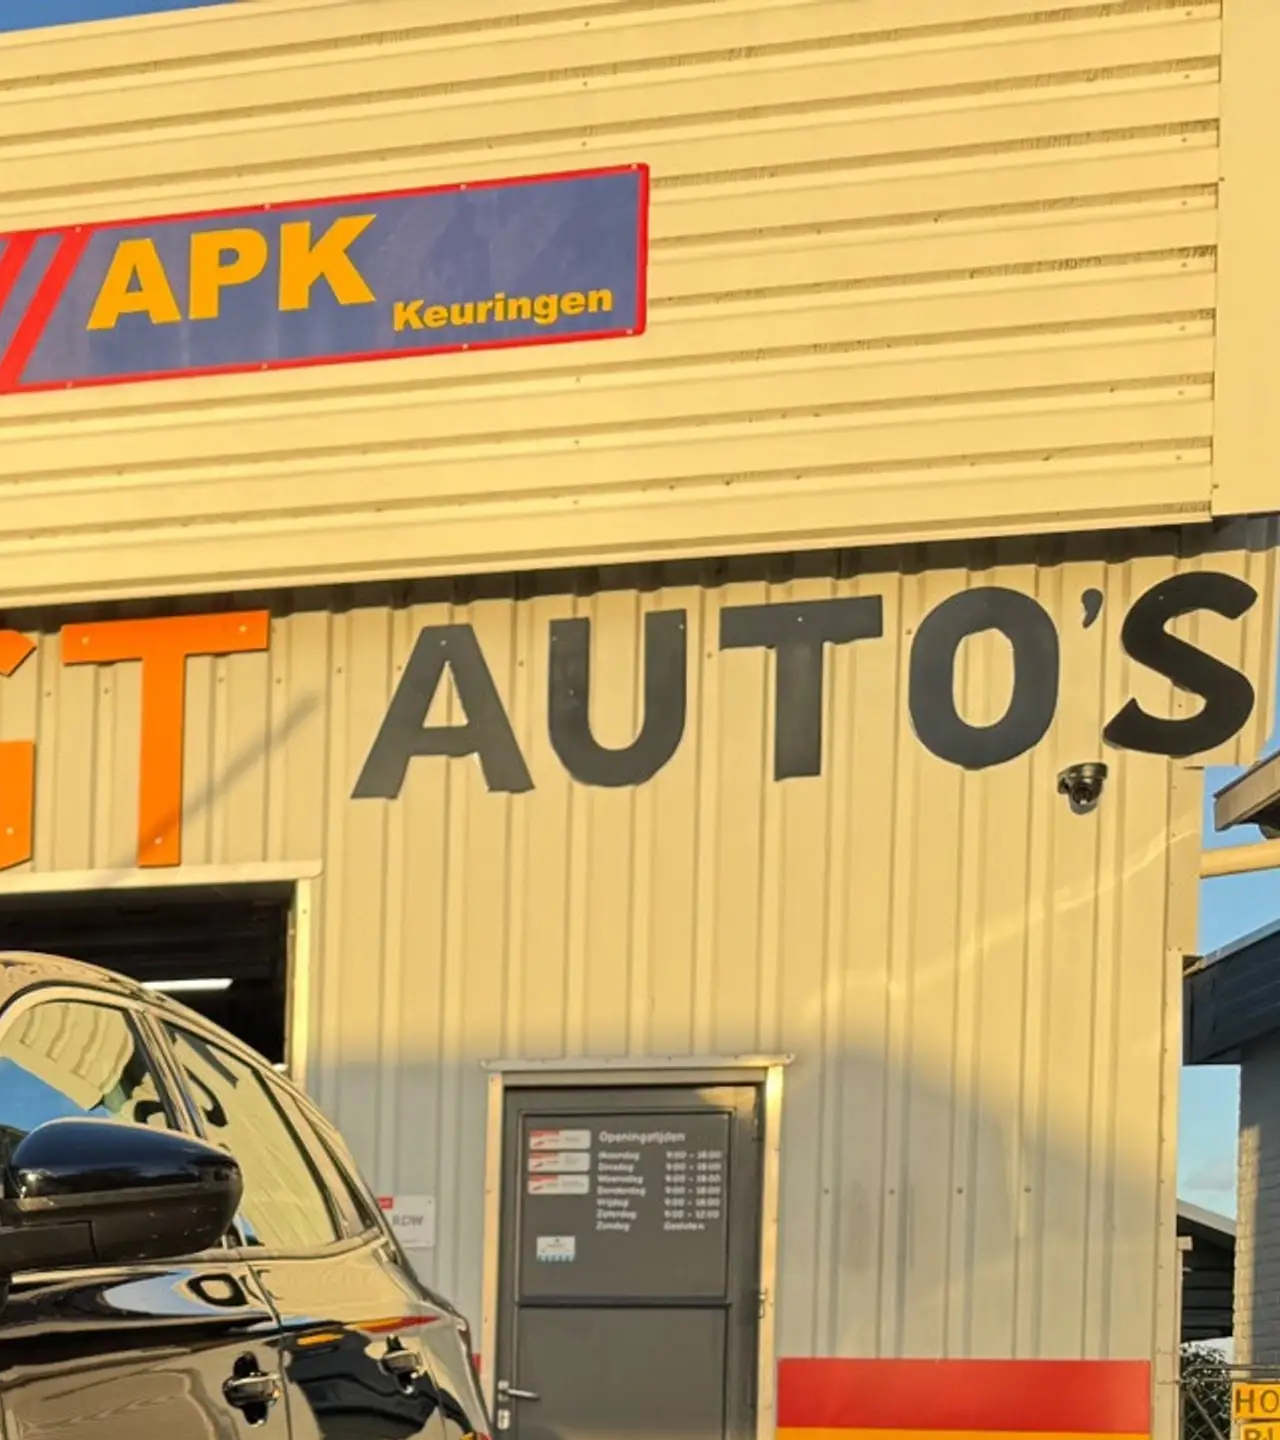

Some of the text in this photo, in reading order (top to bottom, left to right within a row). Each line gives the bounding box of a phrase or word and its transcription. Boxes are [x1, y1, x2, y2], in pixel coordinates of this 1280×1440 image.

[86, 214, 377, 330] APK
[393, 288, 613, 332] Keuringen
[350, 570, 1259, 799] AUTO'S
[598, 1130, 687, 1145] Openingstijden
